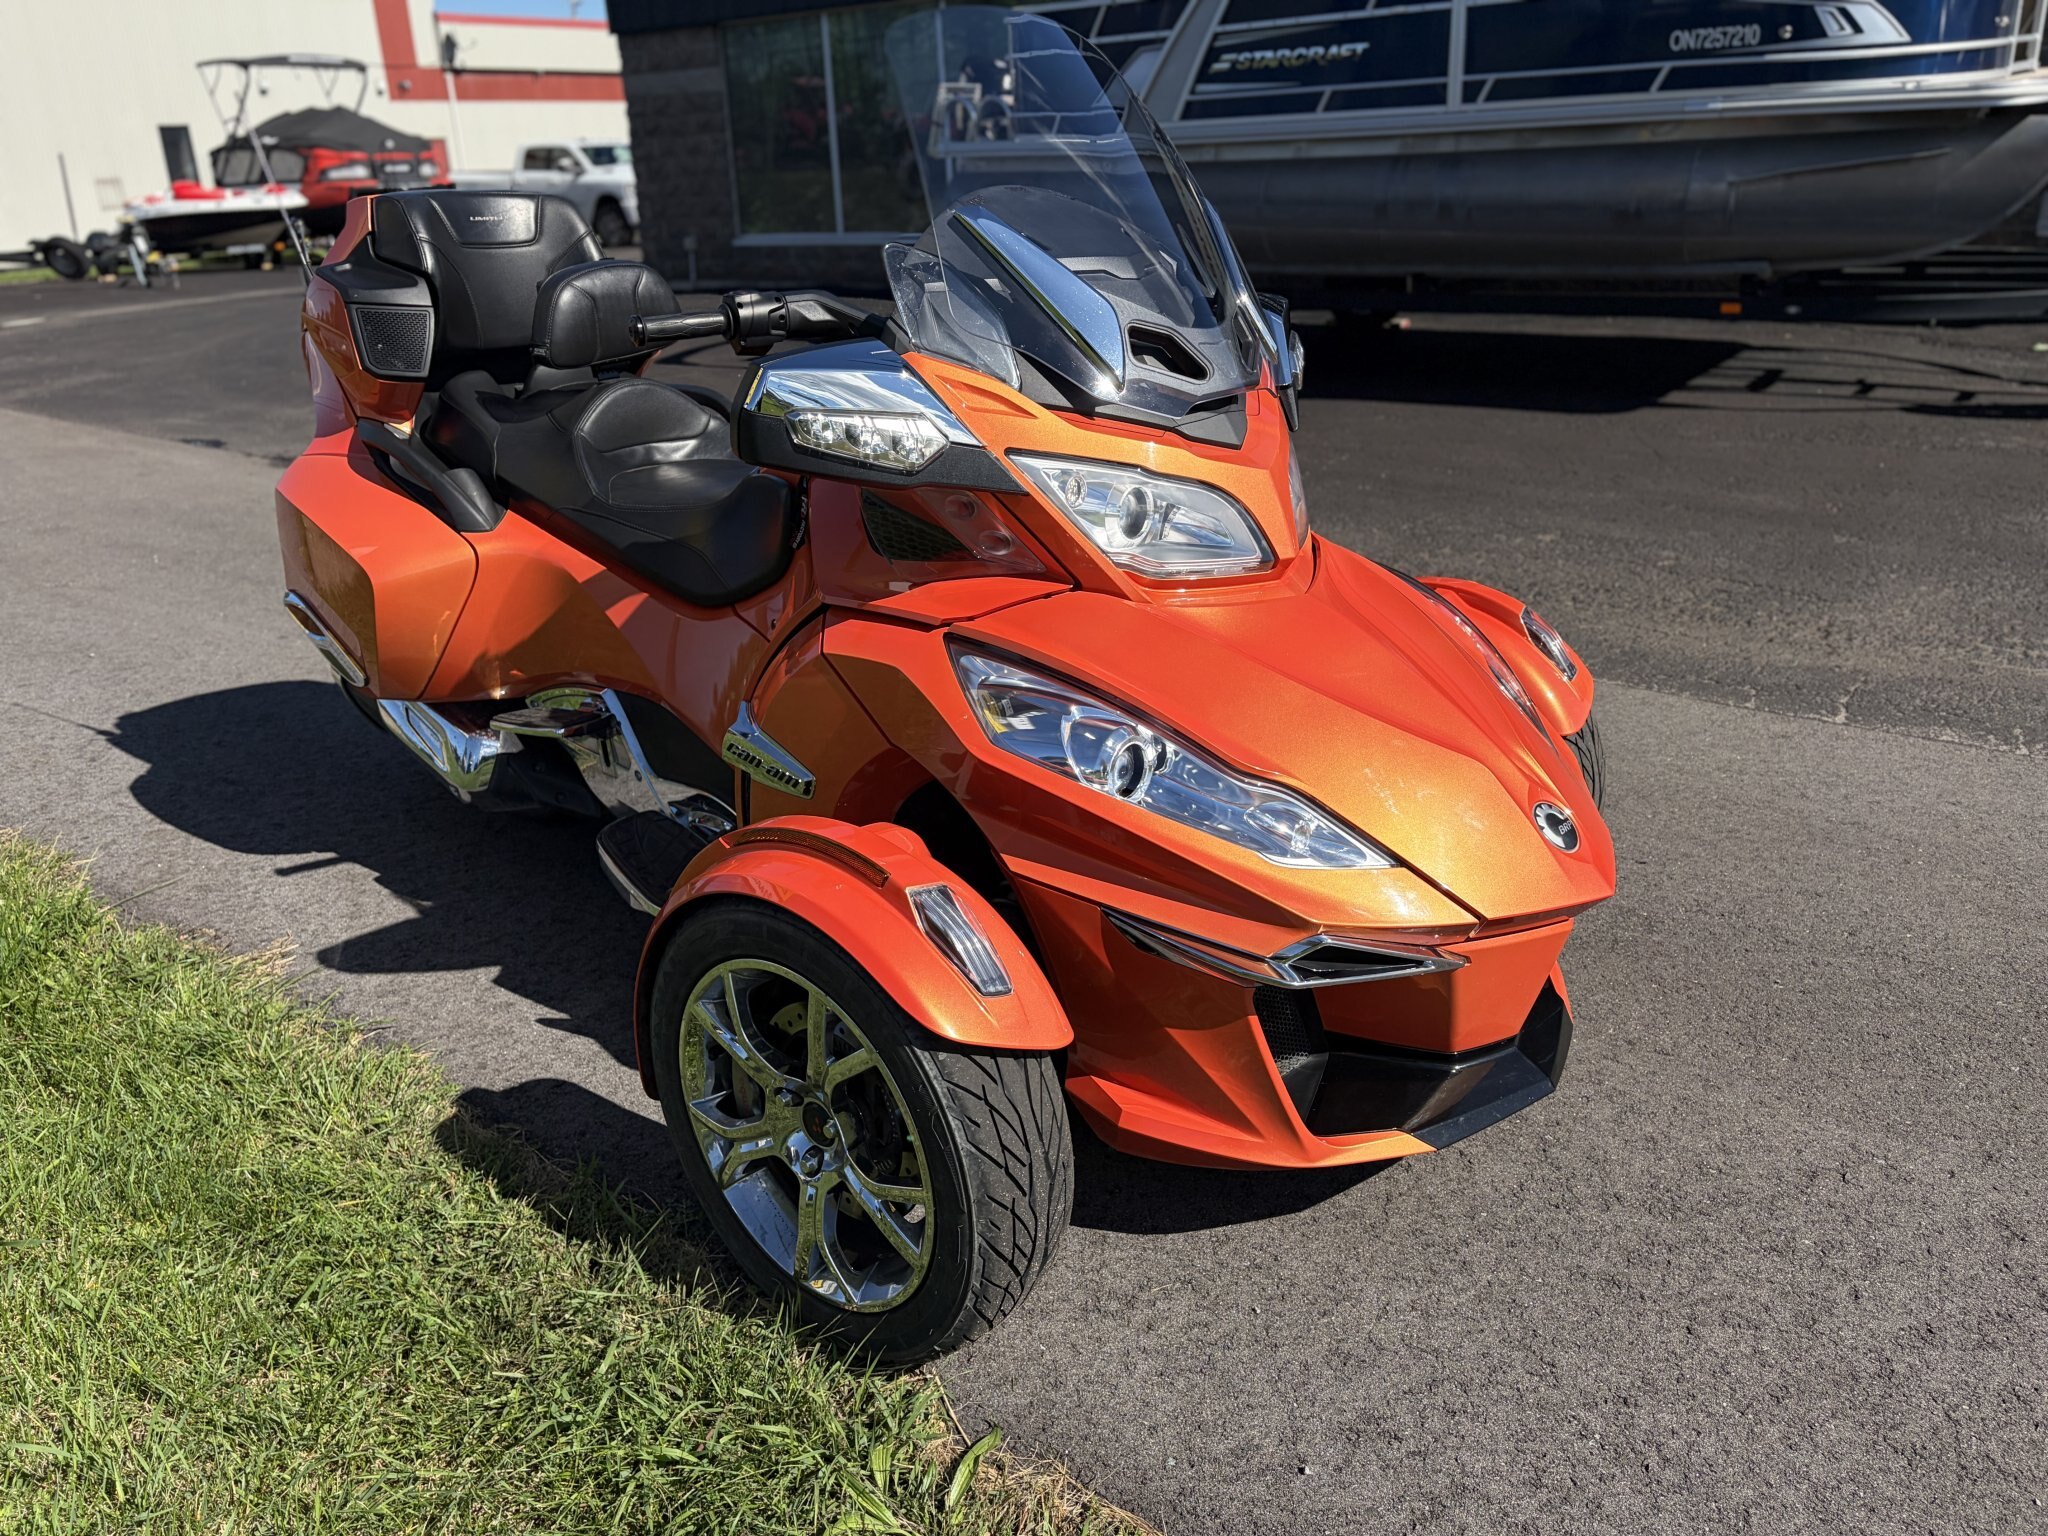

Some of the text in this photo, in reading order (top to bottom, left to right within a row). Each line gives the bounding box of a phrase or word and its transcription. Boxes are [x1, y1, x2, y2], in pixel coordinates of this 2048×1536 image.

[1669, 23, 1761, 52] ON7257210
[1235, 42, 1370, 70] STARCRAFT
[726, 742, 801, 789] can-am
[1558, 820, 1573, 835] BRP
